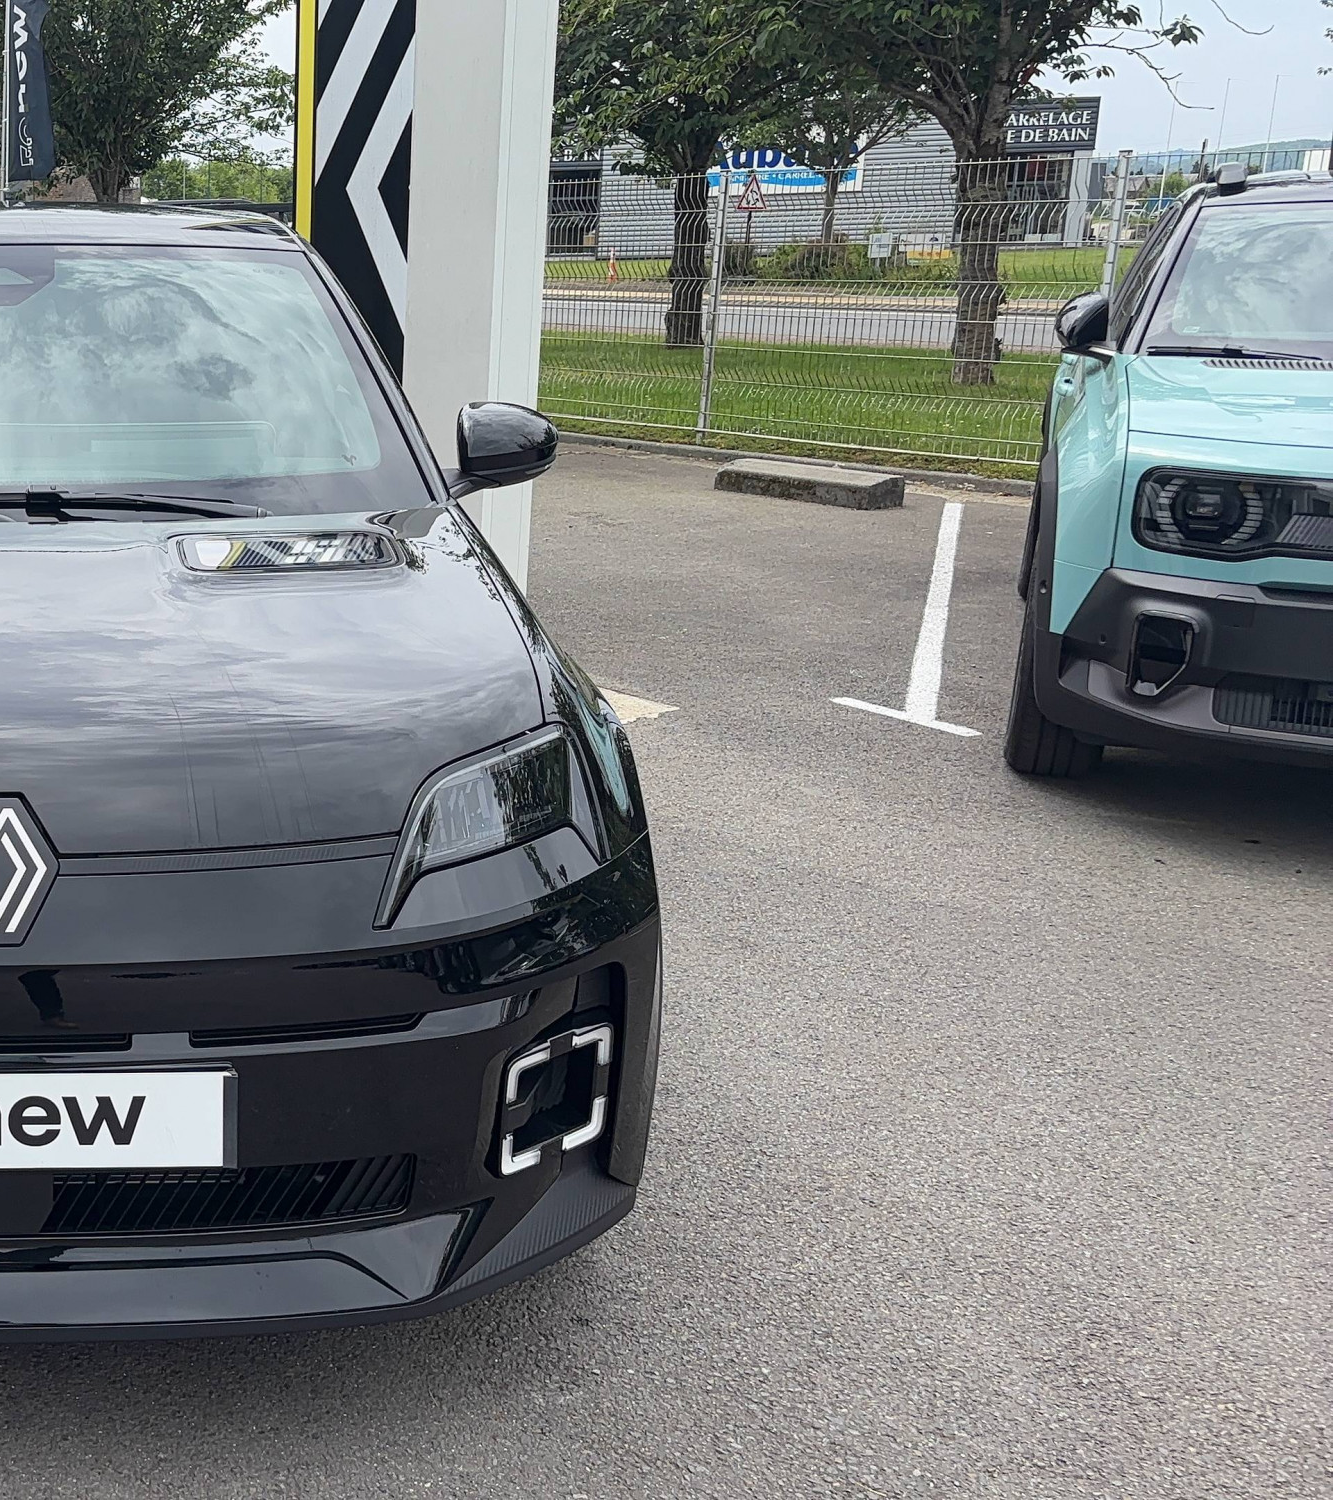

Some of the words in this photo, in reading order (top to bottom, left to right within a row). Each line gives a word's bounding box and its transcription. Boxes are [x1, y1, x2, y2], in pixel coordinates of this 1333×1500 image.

[1004, 110, 1092, 127] ARRELAGE
[1020, 128, 1045, 143] DE
[1047, 127, 1090, 142] BAIN
